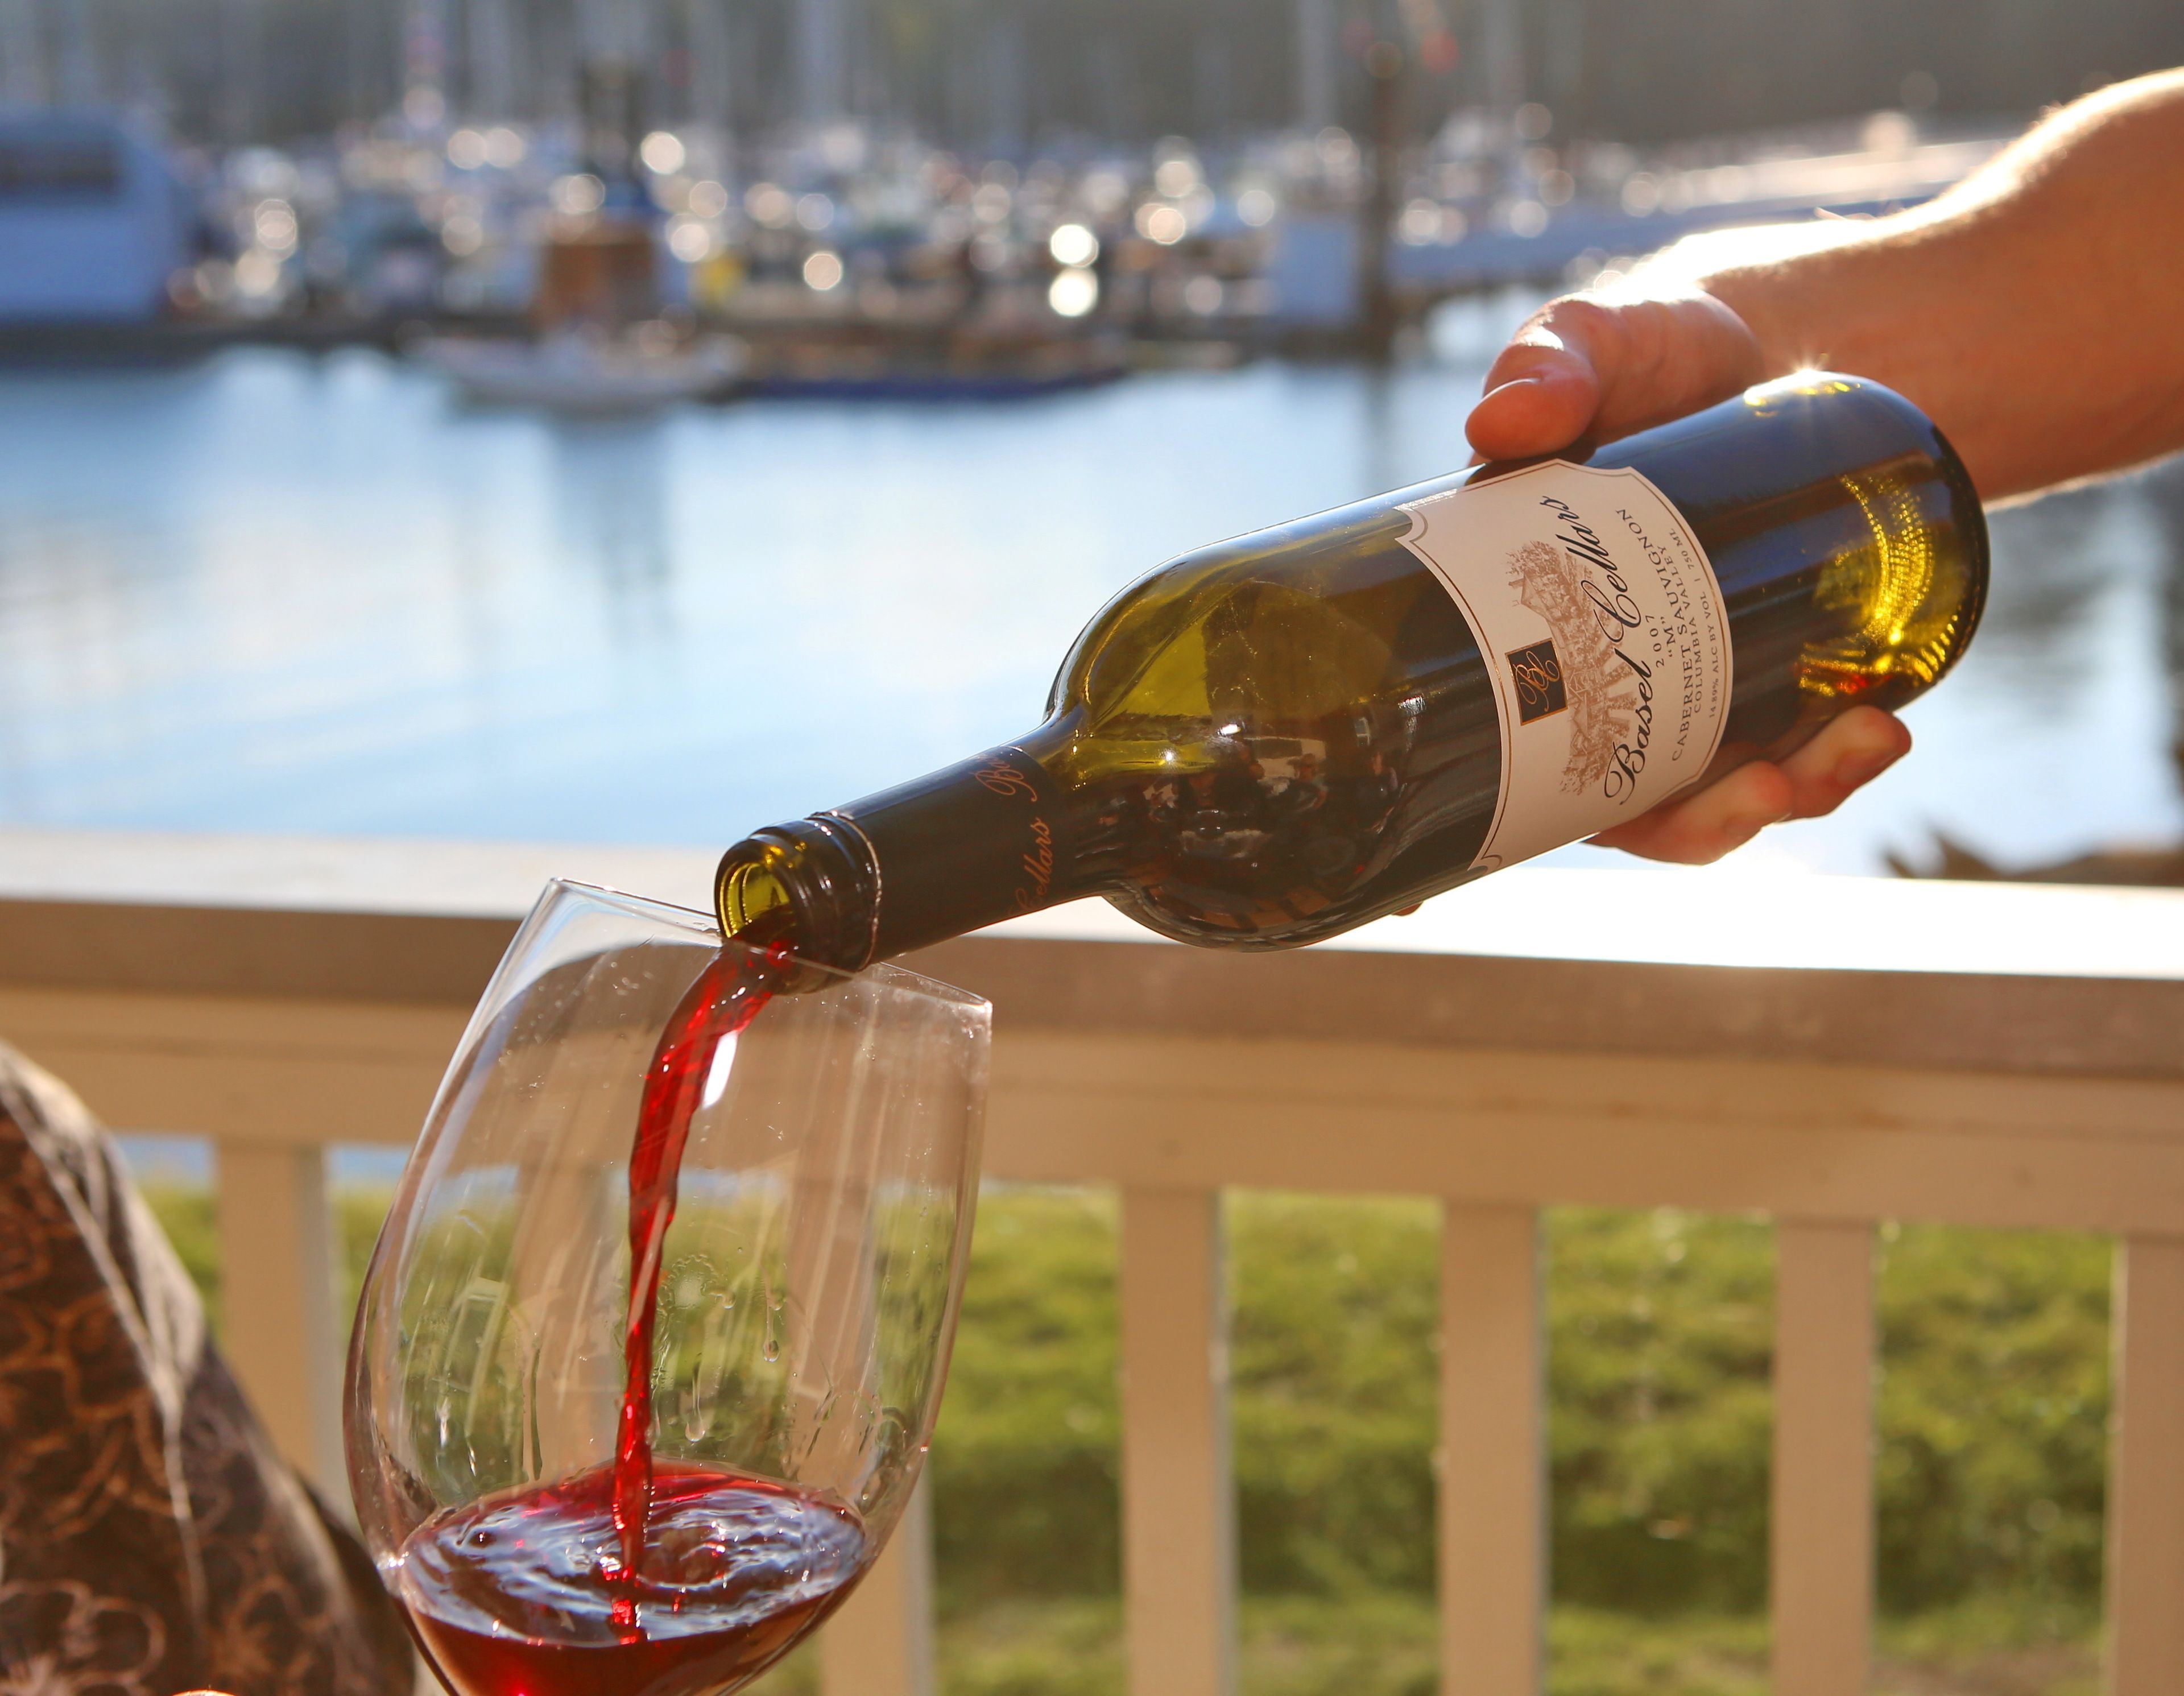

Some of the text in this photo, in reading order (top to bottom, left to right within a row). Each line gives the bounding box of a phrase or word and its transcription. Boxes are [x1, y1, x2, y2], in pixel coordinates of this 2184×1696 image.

[1669, 528, 1683, 547] ML
[1681, 551, 1695, 570] 750
[1699, 591, 1711, 619] VOL
[1615, 509, 1693, 761] CABERNET SAUVIGNON
[1645, 615, 1665, 668] 2007
[1657, 545, 1703, 713] COLUMBIA VALLEY
[1707, 624, 1716, 642] BY
[1539, 495, 1653, 805] Basel Cellars
